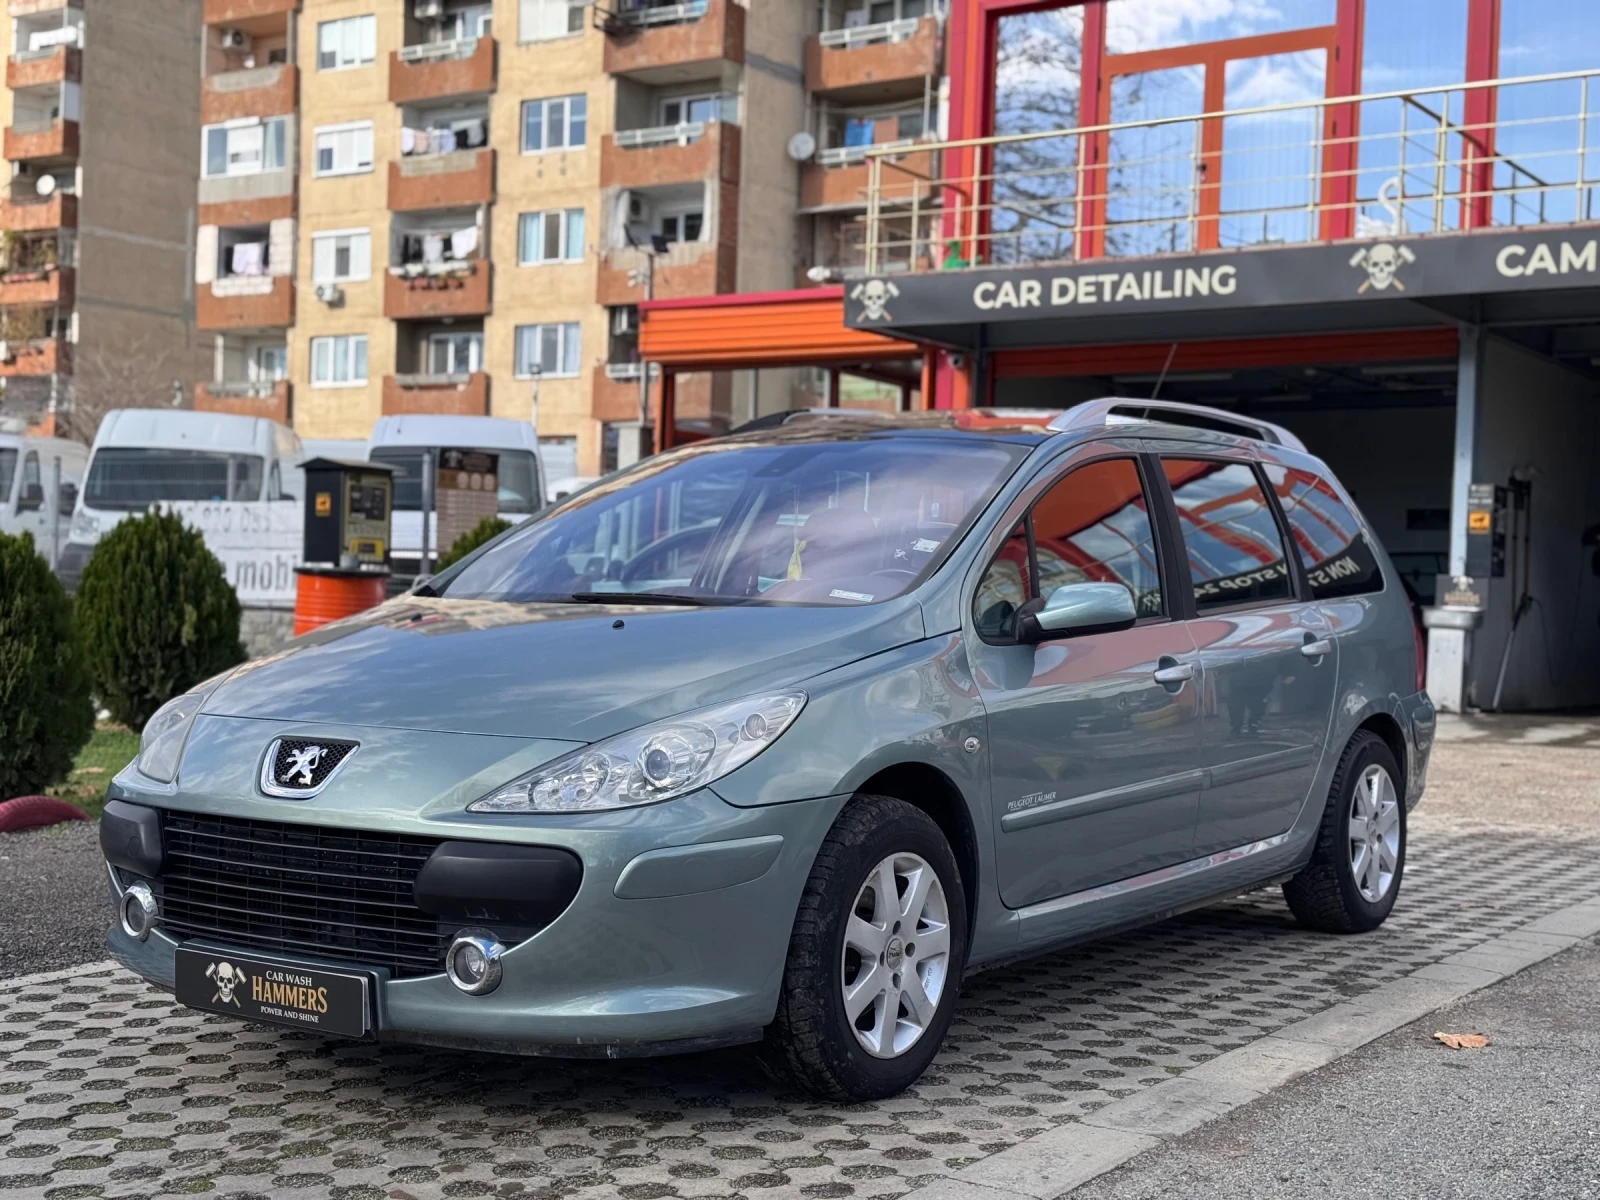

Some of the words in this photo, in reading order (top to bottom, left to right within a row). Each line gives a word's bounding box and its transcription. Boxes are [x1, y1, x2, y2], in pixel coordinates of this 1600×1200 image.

[1495, 239, 1597, 278] CAM
[973, 280, 1041, 309] CAR
[1050, 265, 1237, 305] DETAILING
[1008, 797, 1033, 810] PEUGEOT
[1034, 791, 1056, 803] LAUMER
[266, 970, 284, 982] CAR
[285, 973, 312, 987] WASH
[252, 975, 328, 1014] HAMMERS
[260, 1005, 283, 1017] POWER
[283, 1011, 298, 1019] AND
[298, 1013, 319, 1023] SHINE
